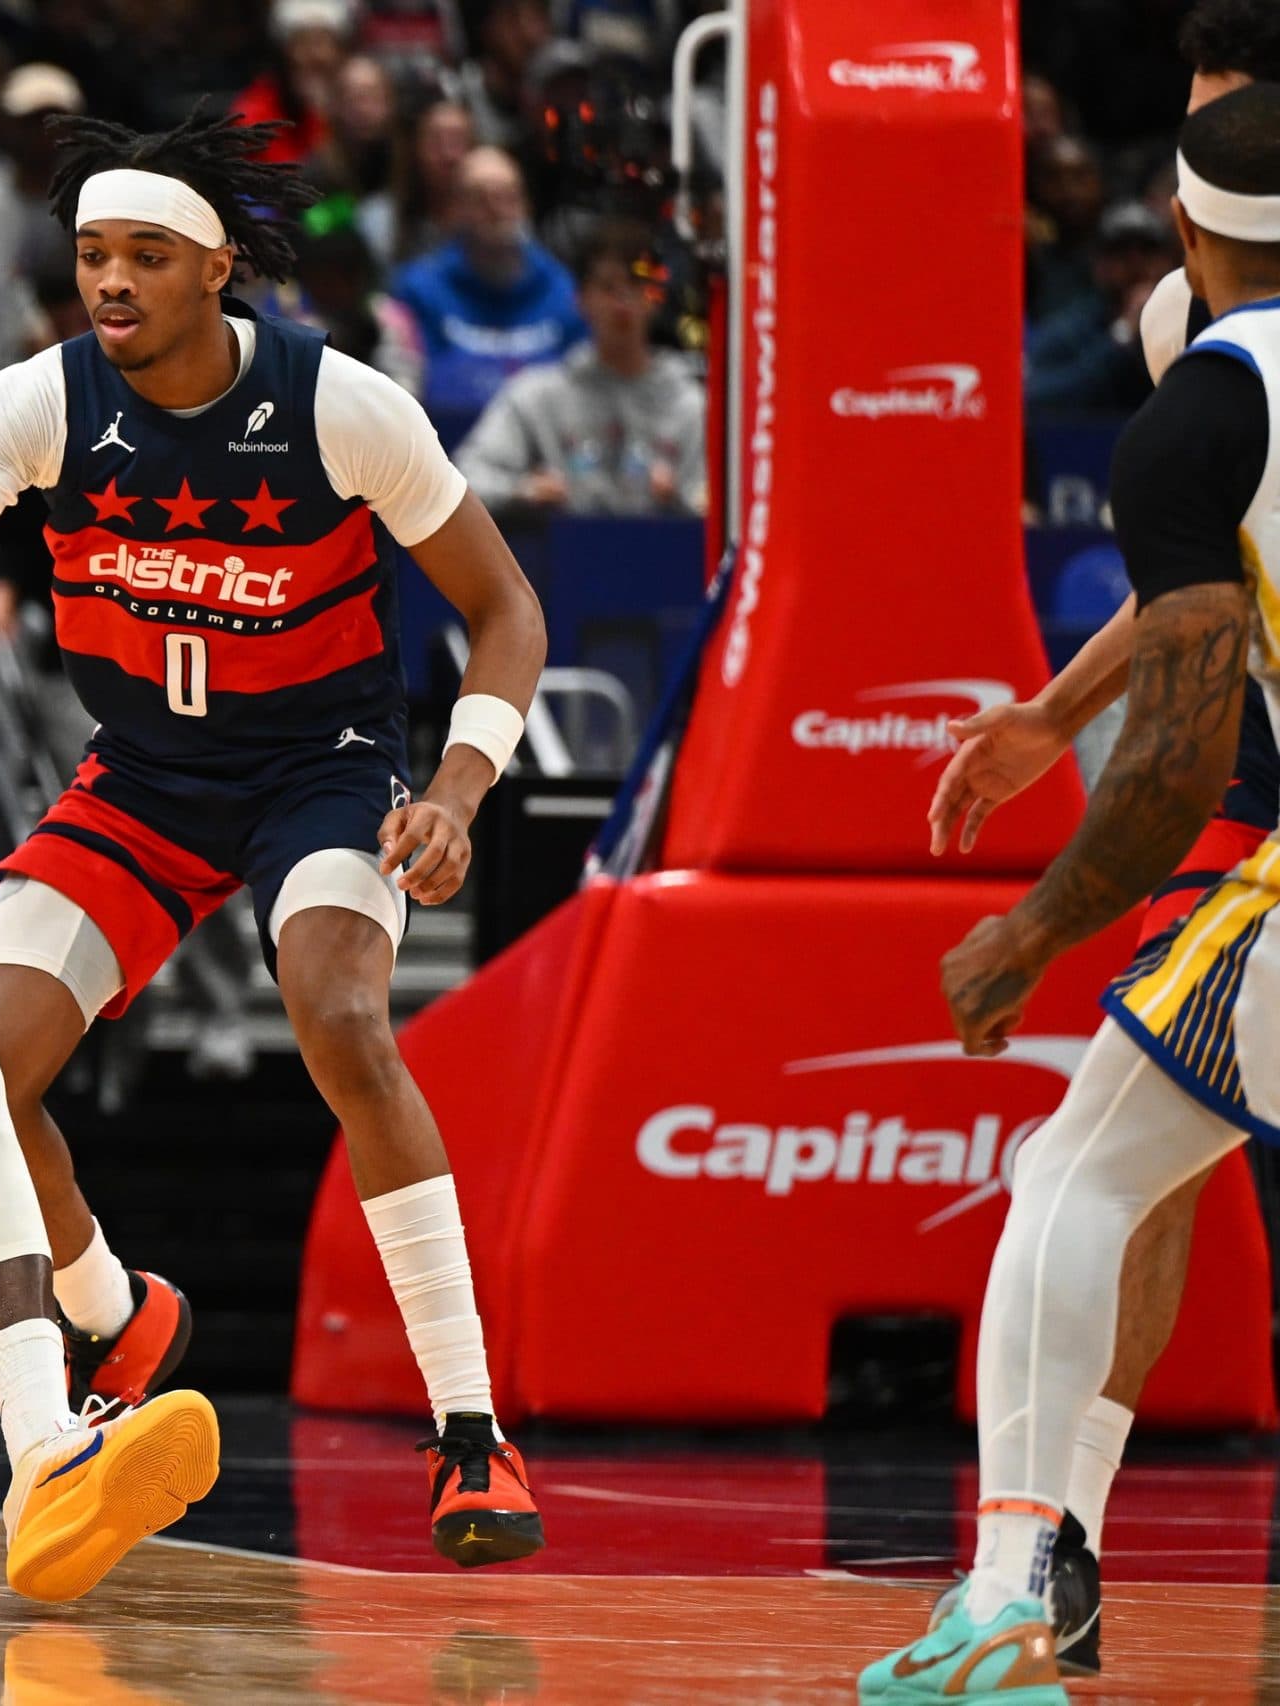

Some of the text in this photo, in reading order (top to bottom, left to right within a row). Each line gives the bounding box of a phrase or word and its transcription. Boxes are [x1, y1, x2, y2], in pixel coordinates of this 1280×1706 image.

[228, 441, 289, 453] Robinhood
[88, 543, 294, 608] district
[140, 547, 176, 561] THE
[164, 632, 208, 718] 0
[636, 1104, 1002, 1197] Capital
